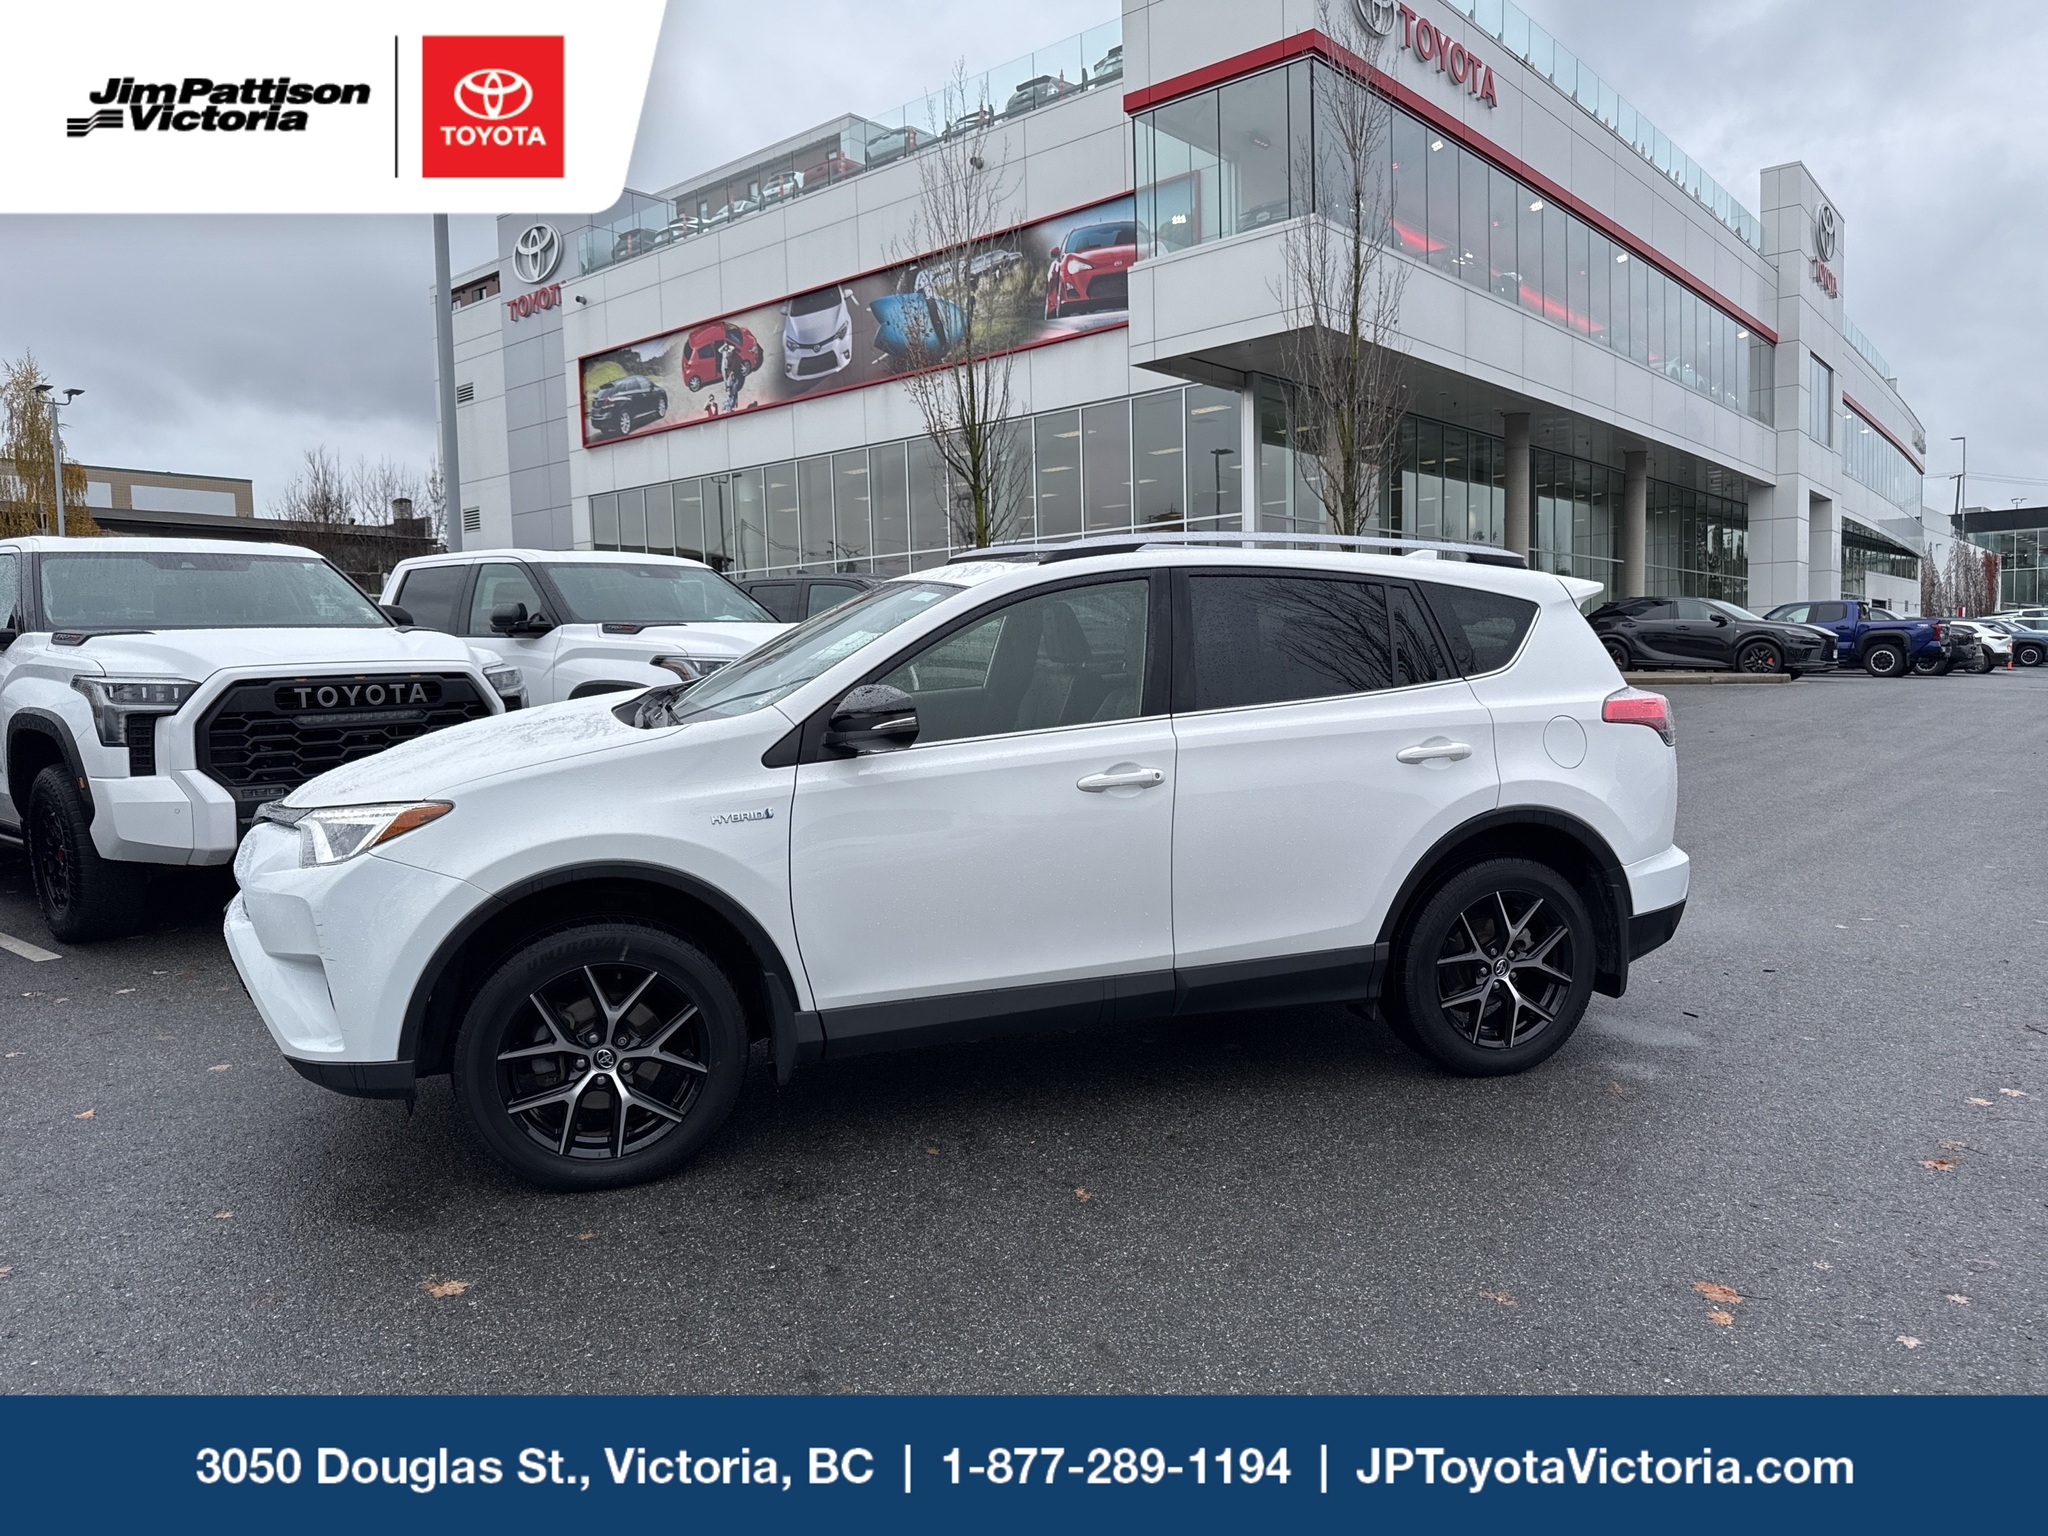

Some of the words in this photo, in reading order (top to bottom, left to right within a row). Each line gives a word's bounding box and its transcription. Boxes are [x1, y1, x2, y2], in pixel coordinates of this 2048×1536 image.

[1398, 2, 1497, 108] TOYOTA
[507, 280, 566, 322] TOYOT
[294, 683, 428, 708] TOYOTA
[711, 811, 763, 825] HYBRID
